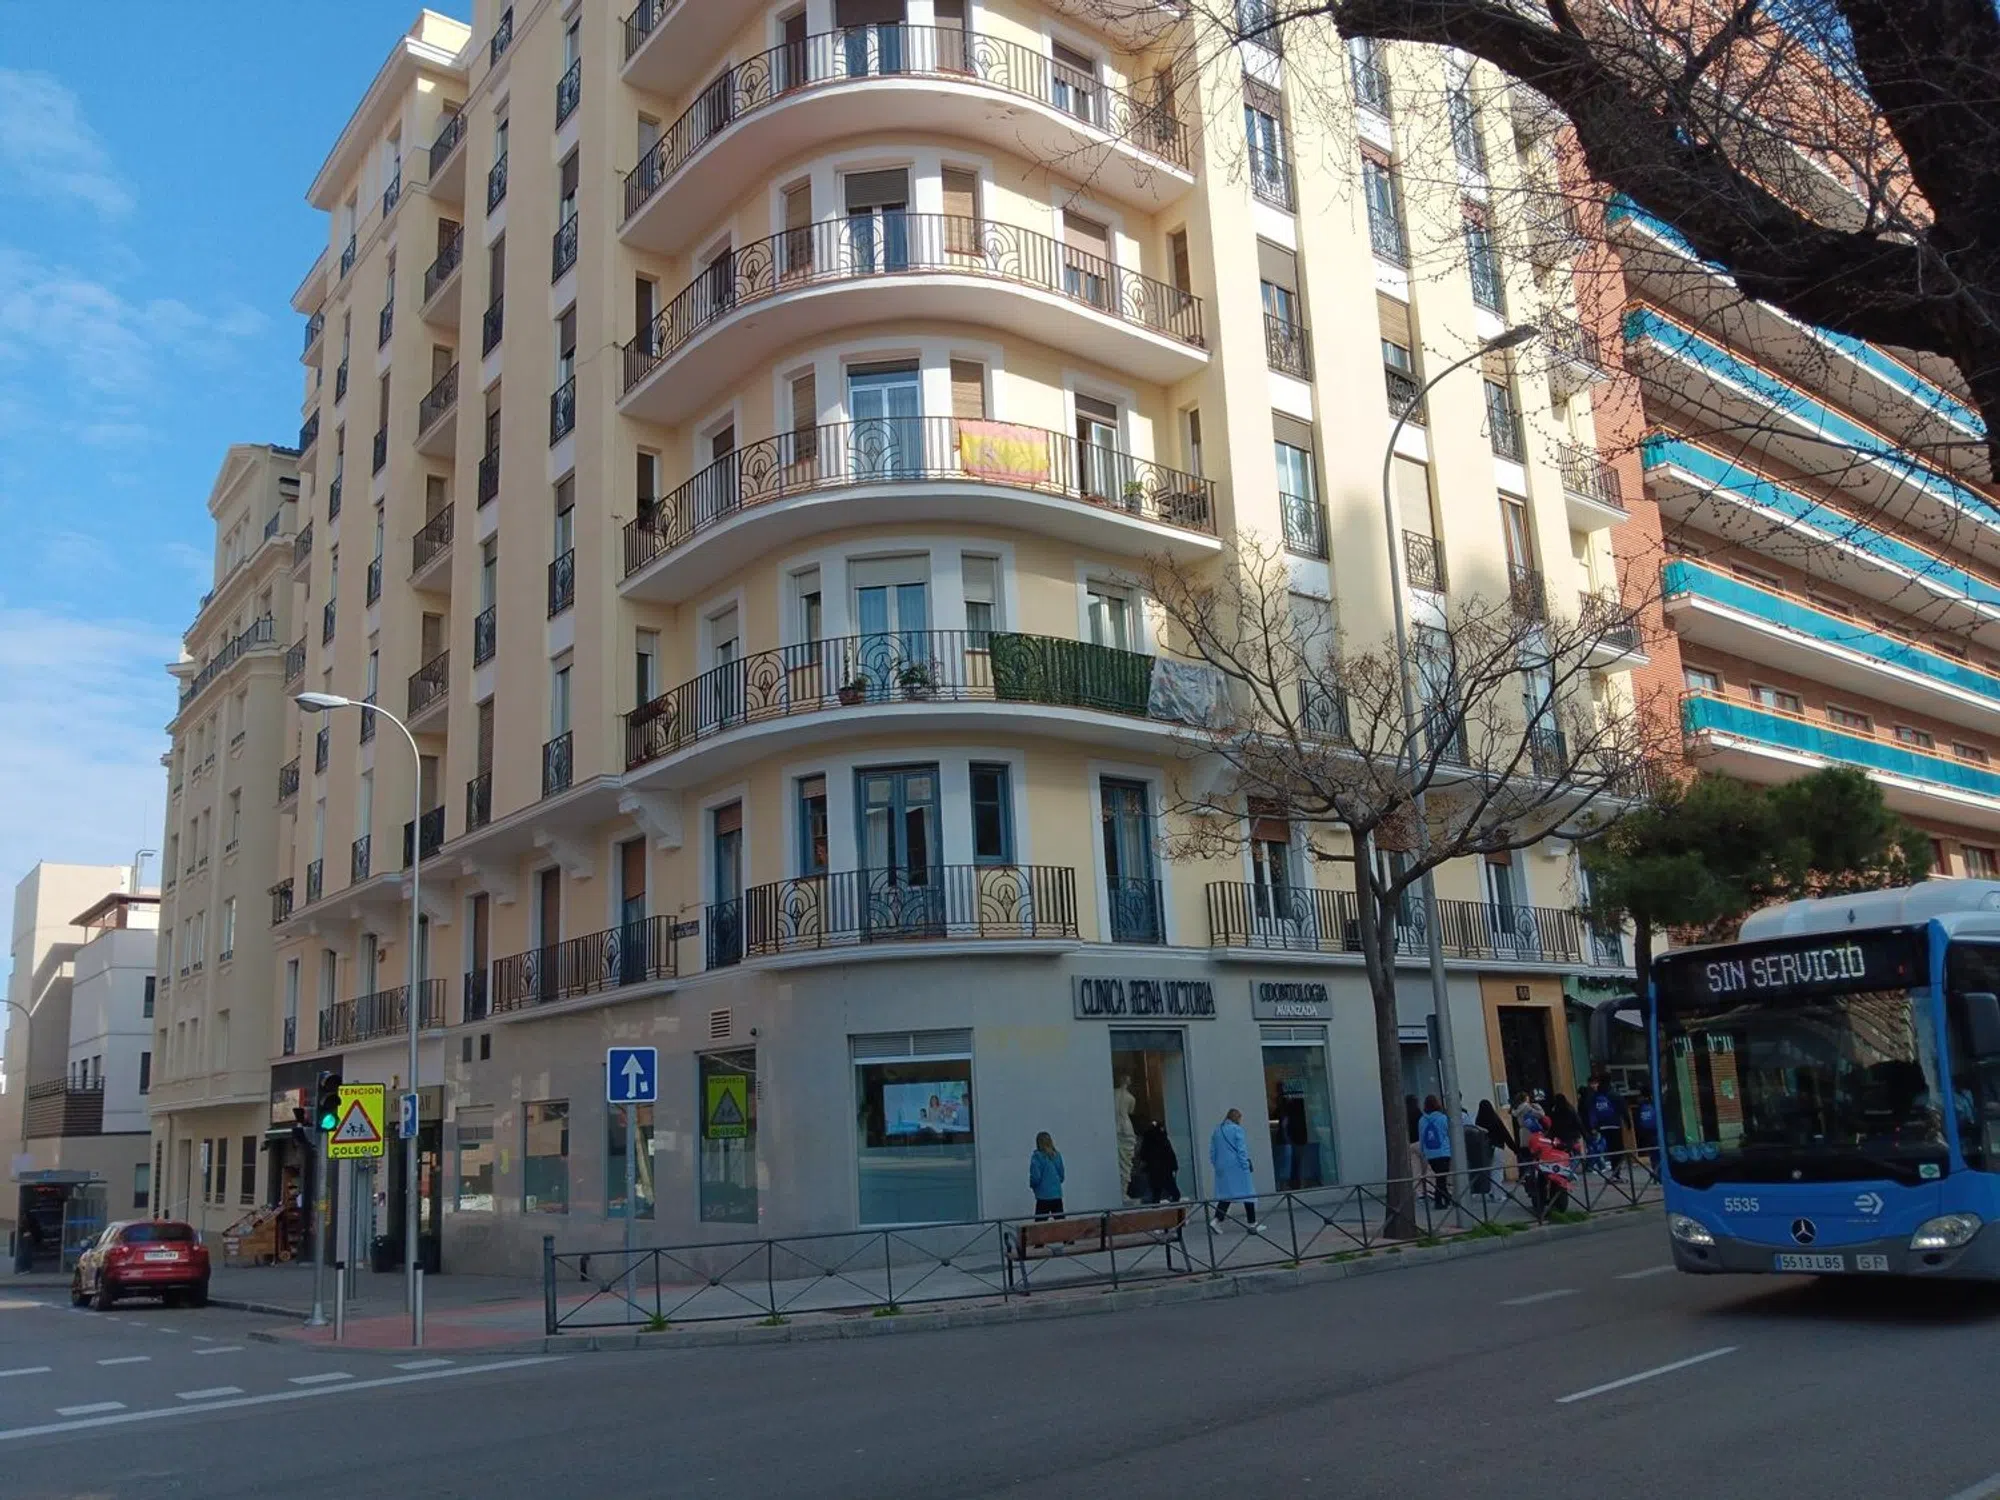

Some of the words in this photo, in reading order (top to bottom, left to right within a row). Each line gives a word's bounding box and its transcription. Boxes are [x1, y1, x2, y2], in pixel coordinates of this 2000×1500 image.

[1706, 960, 1747, 992] SIN
[1751, 944, 1866, 987] SERVICIO
[1129, 980, 1165, 1015] REINA
[1165, 980, 1216, 1016] VICTORIA
[1276, 1004, 1318, 1016] AVANZADA
[339, 1087, 382, 1096] TENCION
[332, 1145, 379, 1155] COLEGIO
[1725, 1198, 1760, 1212] 5535
